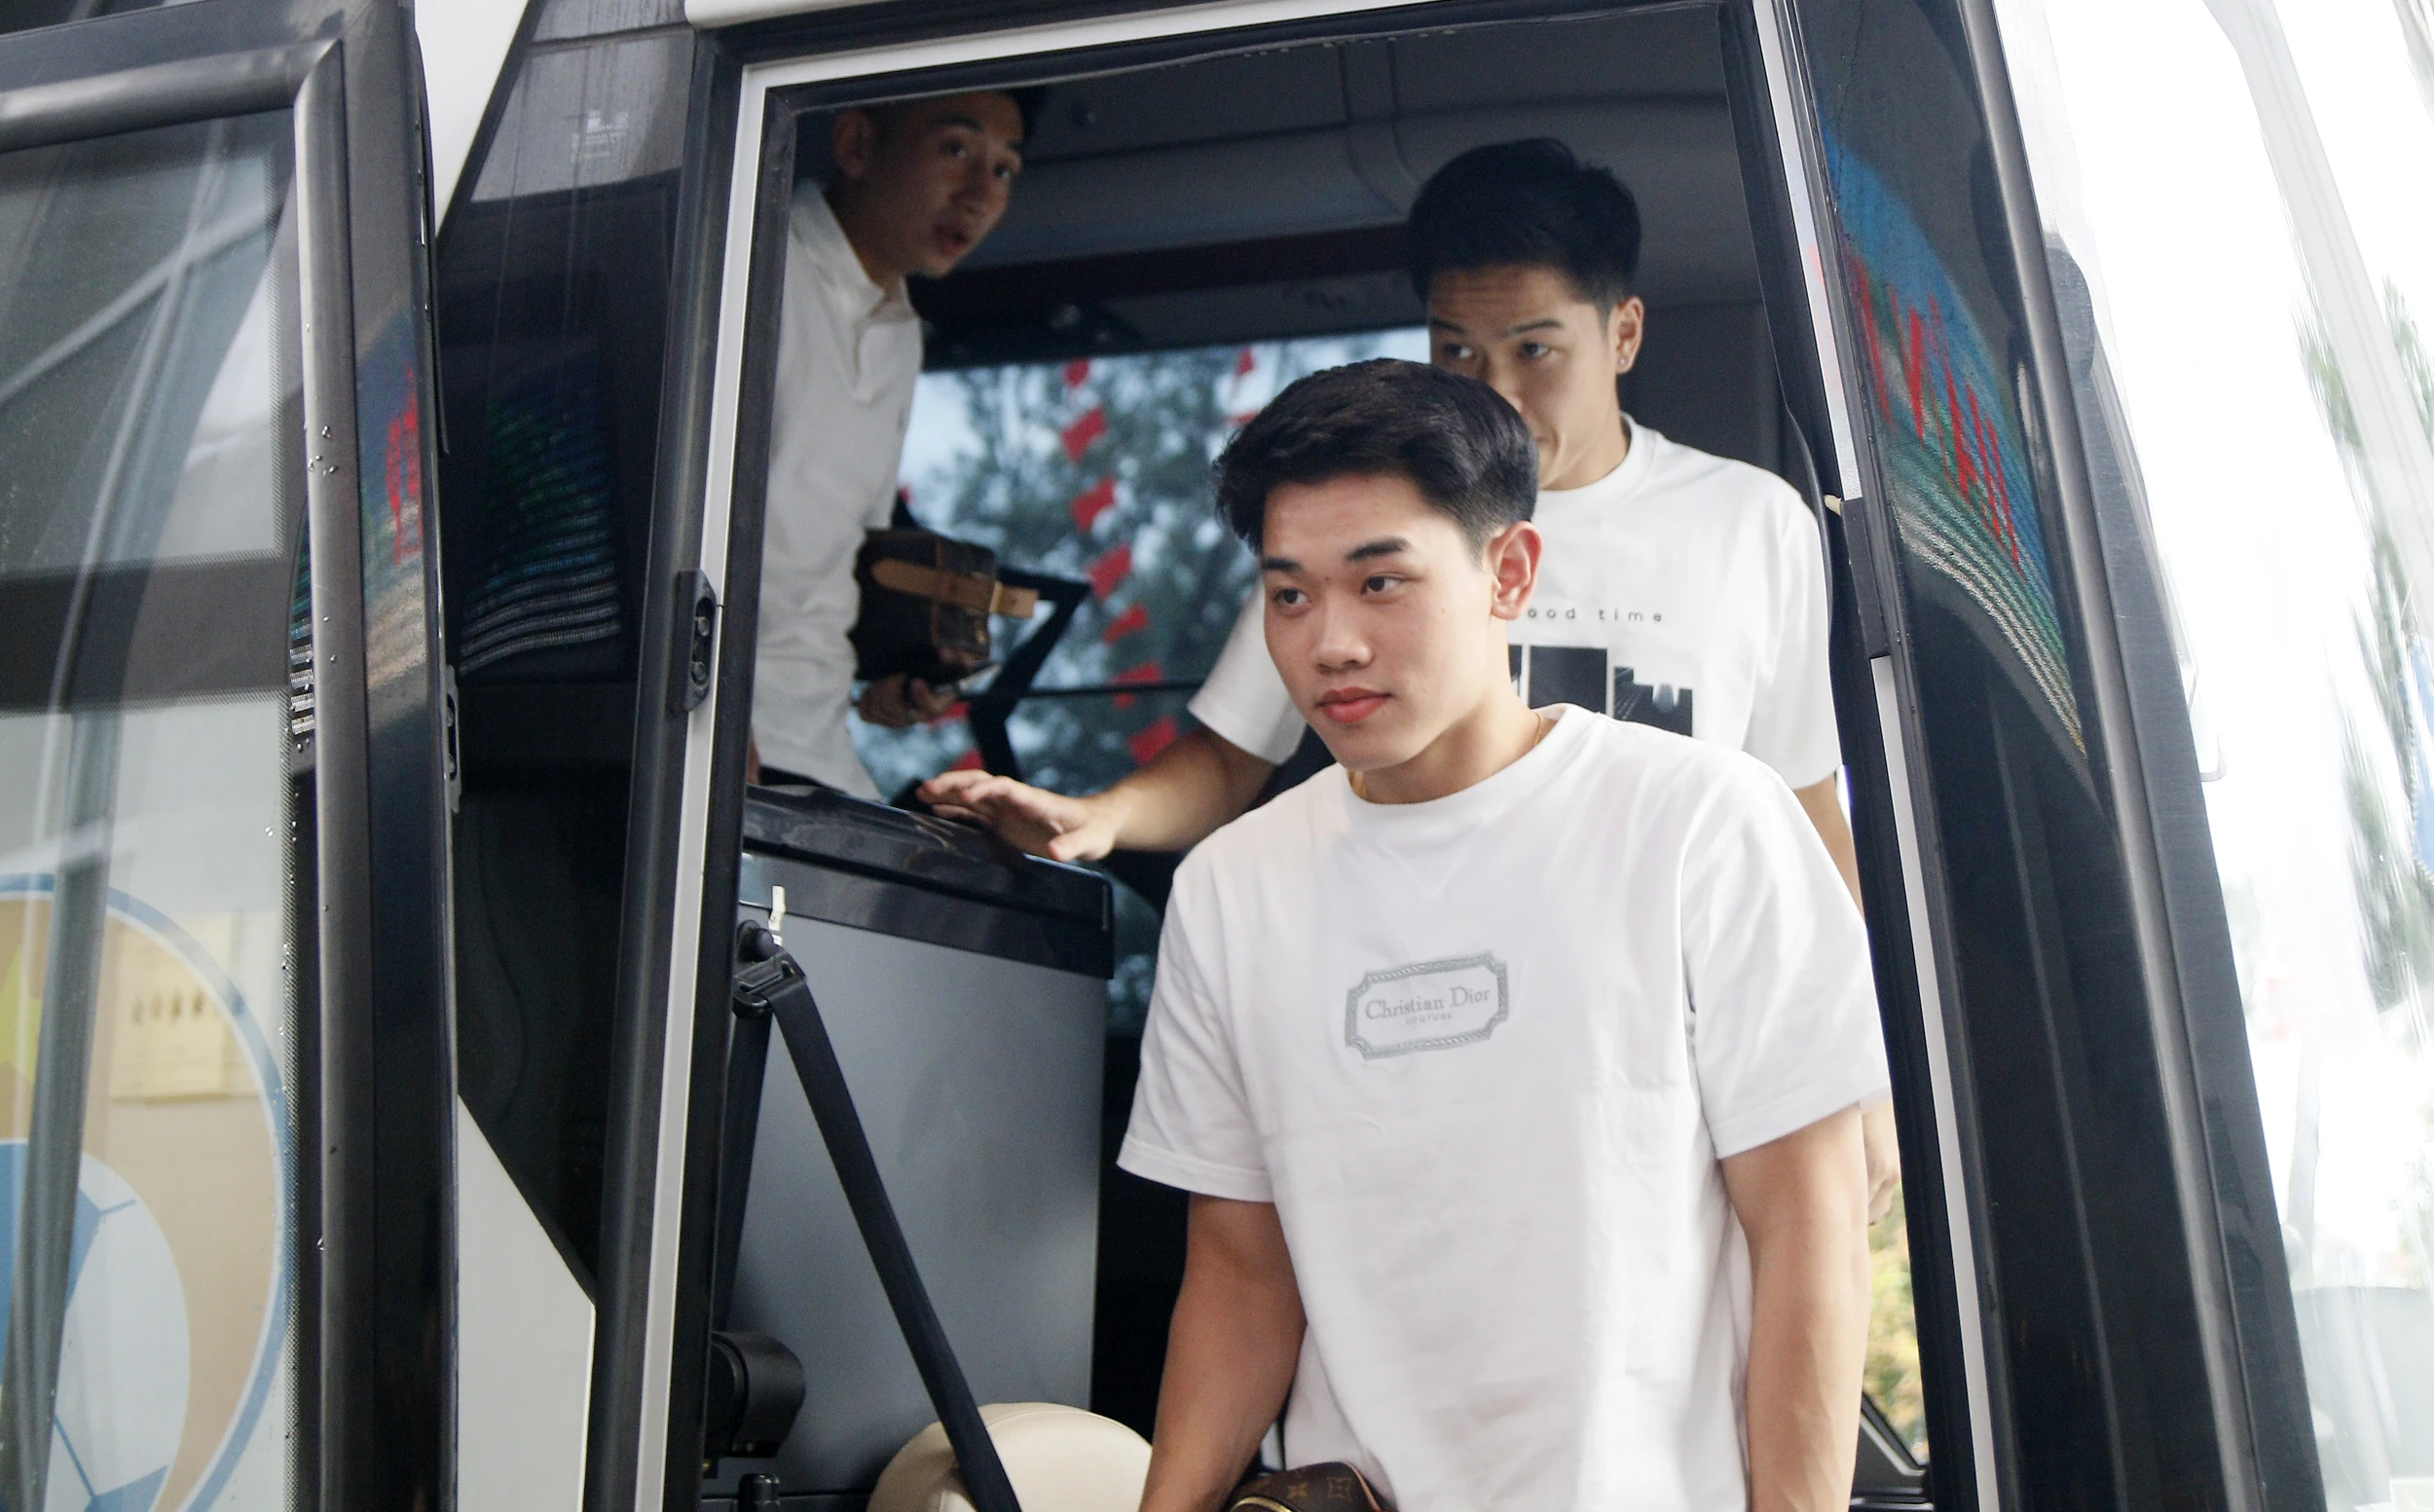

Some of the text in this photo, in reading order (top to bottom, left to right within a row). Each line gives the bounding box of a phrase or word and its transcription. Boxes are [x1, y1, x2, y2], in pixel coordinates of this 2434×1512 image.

[1527, 607, 1663, 622] ood time
[1365, 986, 1490, 1019] Christian Dior
